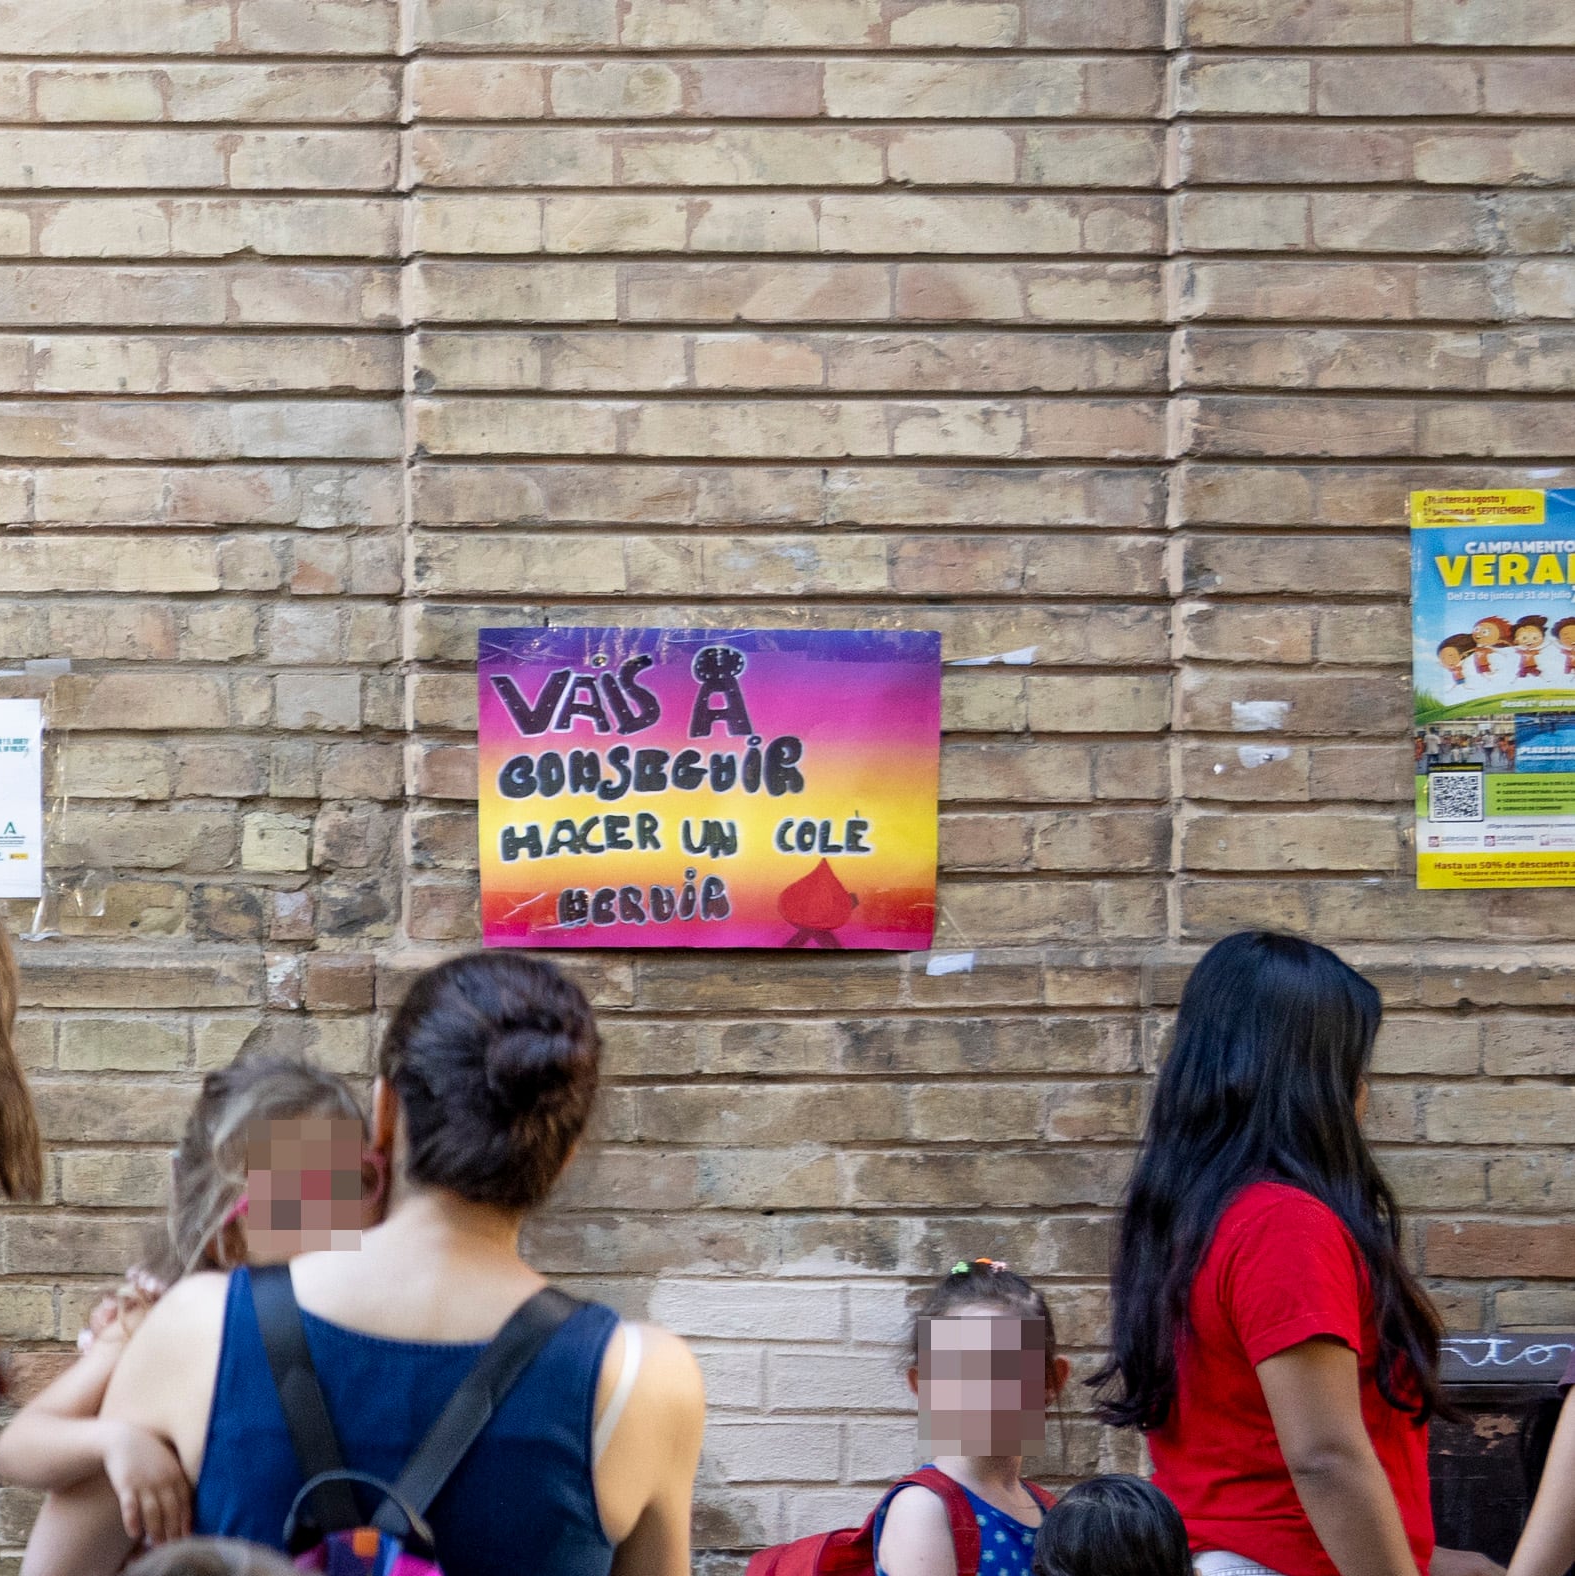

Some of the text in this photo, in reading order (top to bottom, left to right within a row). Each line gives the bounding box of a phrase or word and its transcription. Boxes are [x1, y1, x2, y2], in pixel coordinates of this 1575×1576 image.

[1435, 553, 1575, 588] VERA
[1478, 591, 1489, 600] de
[1490, 591, 1514, 602] junio
[1537, 591, 1548, 600] de
[498, 735, 806, 801] CONSEGUIR
[500, 812, 663, 863] HACER
[681, 818, 739, 859] UN
[1504, 861, 1516, 869] de
[1519, 860, 1570, 869] descuento
